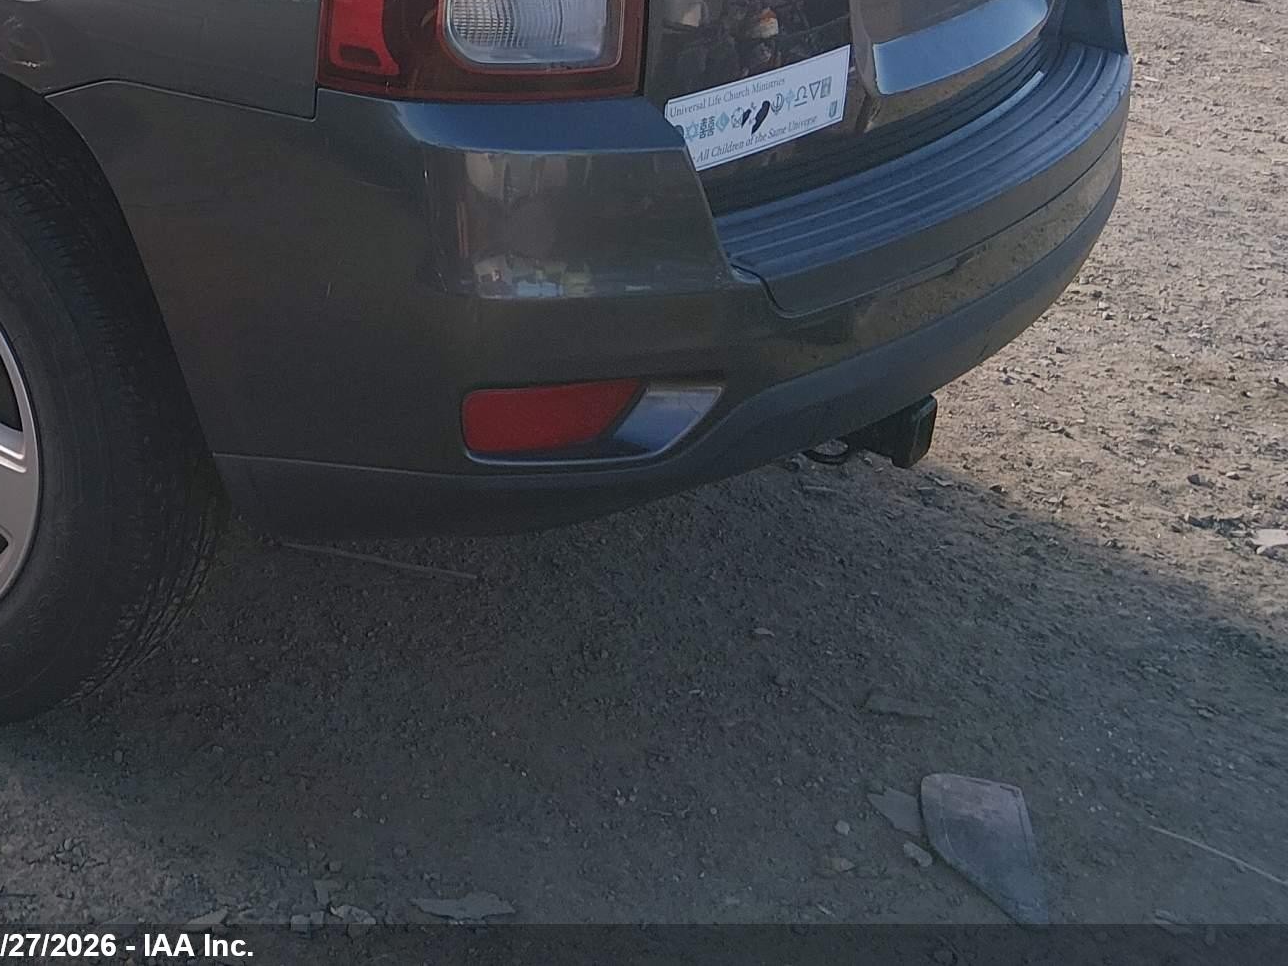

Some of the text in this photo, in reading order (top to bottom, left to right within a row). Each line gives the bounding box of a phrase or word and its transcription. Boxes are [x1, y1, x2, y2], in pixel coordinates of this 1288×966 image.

[669, 78, 785, 118] Universal Life Church Ministries
[697, 116, 817, 162] All Children of the Same Universe
